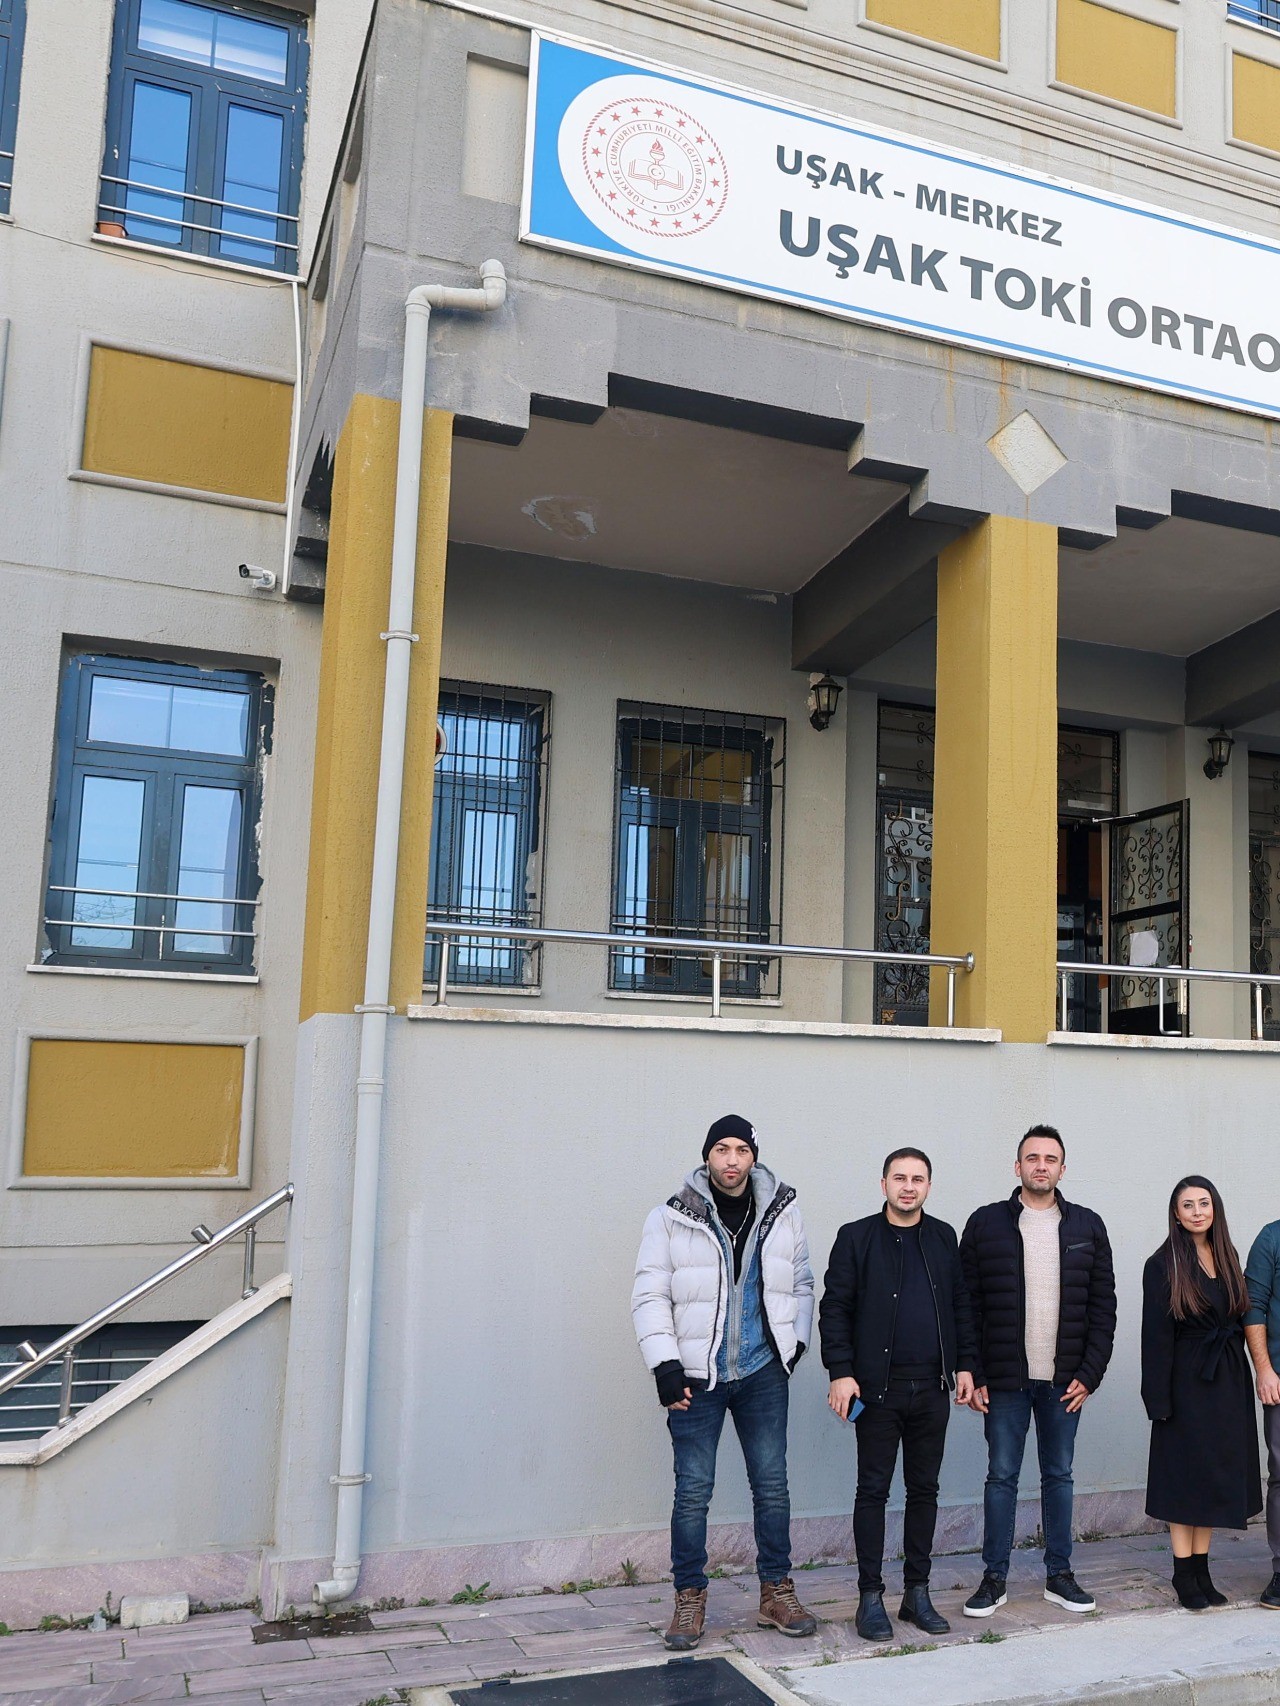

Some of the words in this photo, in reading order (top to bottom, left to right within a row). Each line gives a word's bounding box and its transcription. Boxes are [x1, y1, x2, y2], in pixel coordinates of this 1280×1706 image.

[610, 123, 652, 166] CUMHURİYETİ
[666, 178, 703, 212] BAKANLIĞI
[777, 145, 883, 199] UŞAK
[894, 190, 906, 198] -
[916, 184, 1062, 247] MERKEZ
[780, 209, 949, 292] UŞAK
[960, 256, 1092, 328] TOKİ
